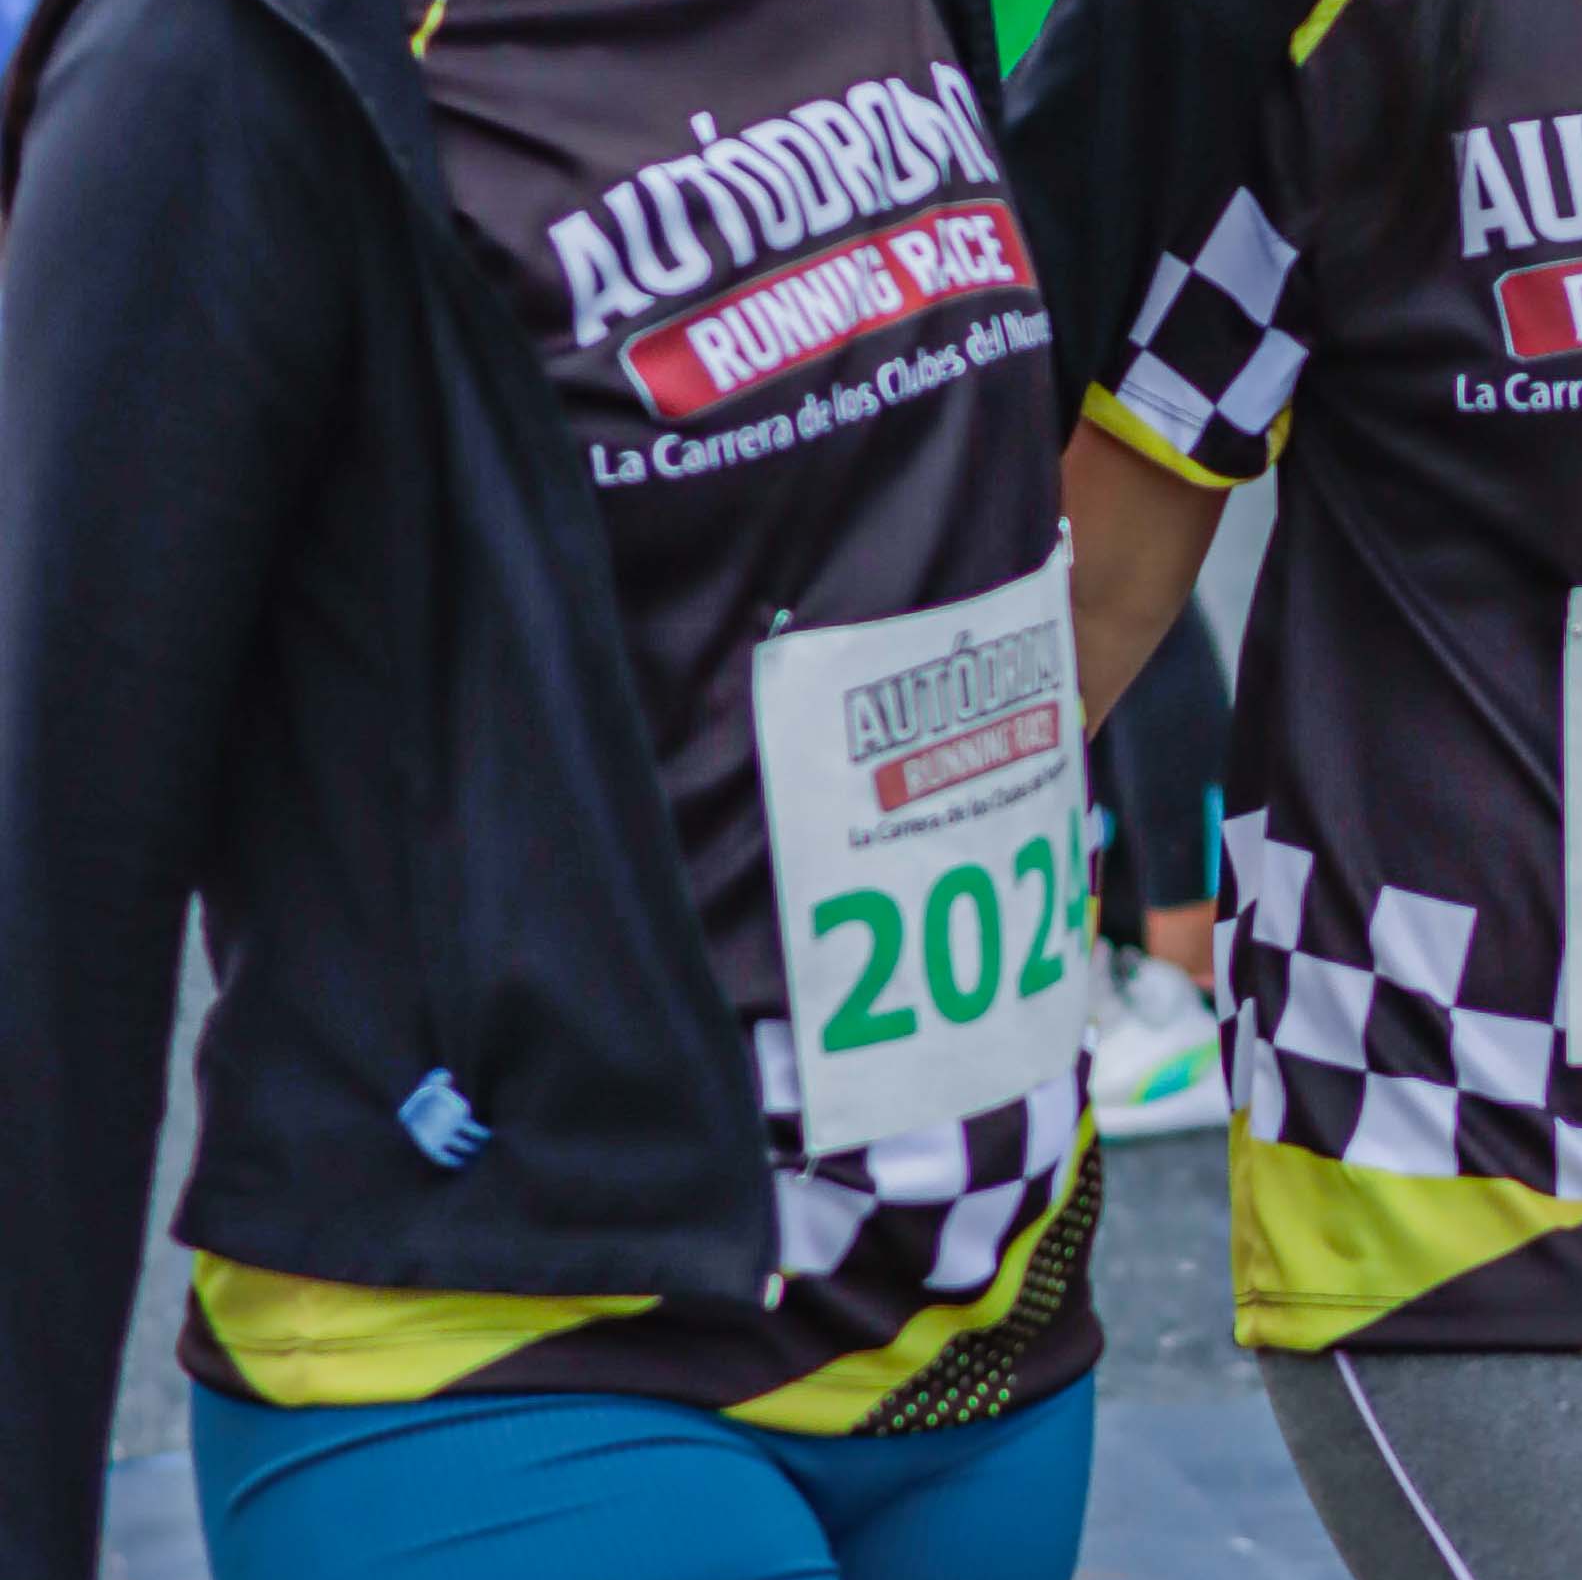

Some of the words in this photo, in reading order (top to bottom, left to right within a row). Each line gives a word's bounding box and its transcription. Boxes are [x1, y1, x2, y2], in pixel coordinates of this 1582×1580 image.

[686, 243, 904, 393] RUNNING
[888, 214, 1016, 298] RACE
[590, 443, 648, 487] La
[653, 413, 796, 479] Carrera
[796, 392, 833, 441] de
[831, 380, 879, 420] los
[1456, 373, 1498, 412] La
